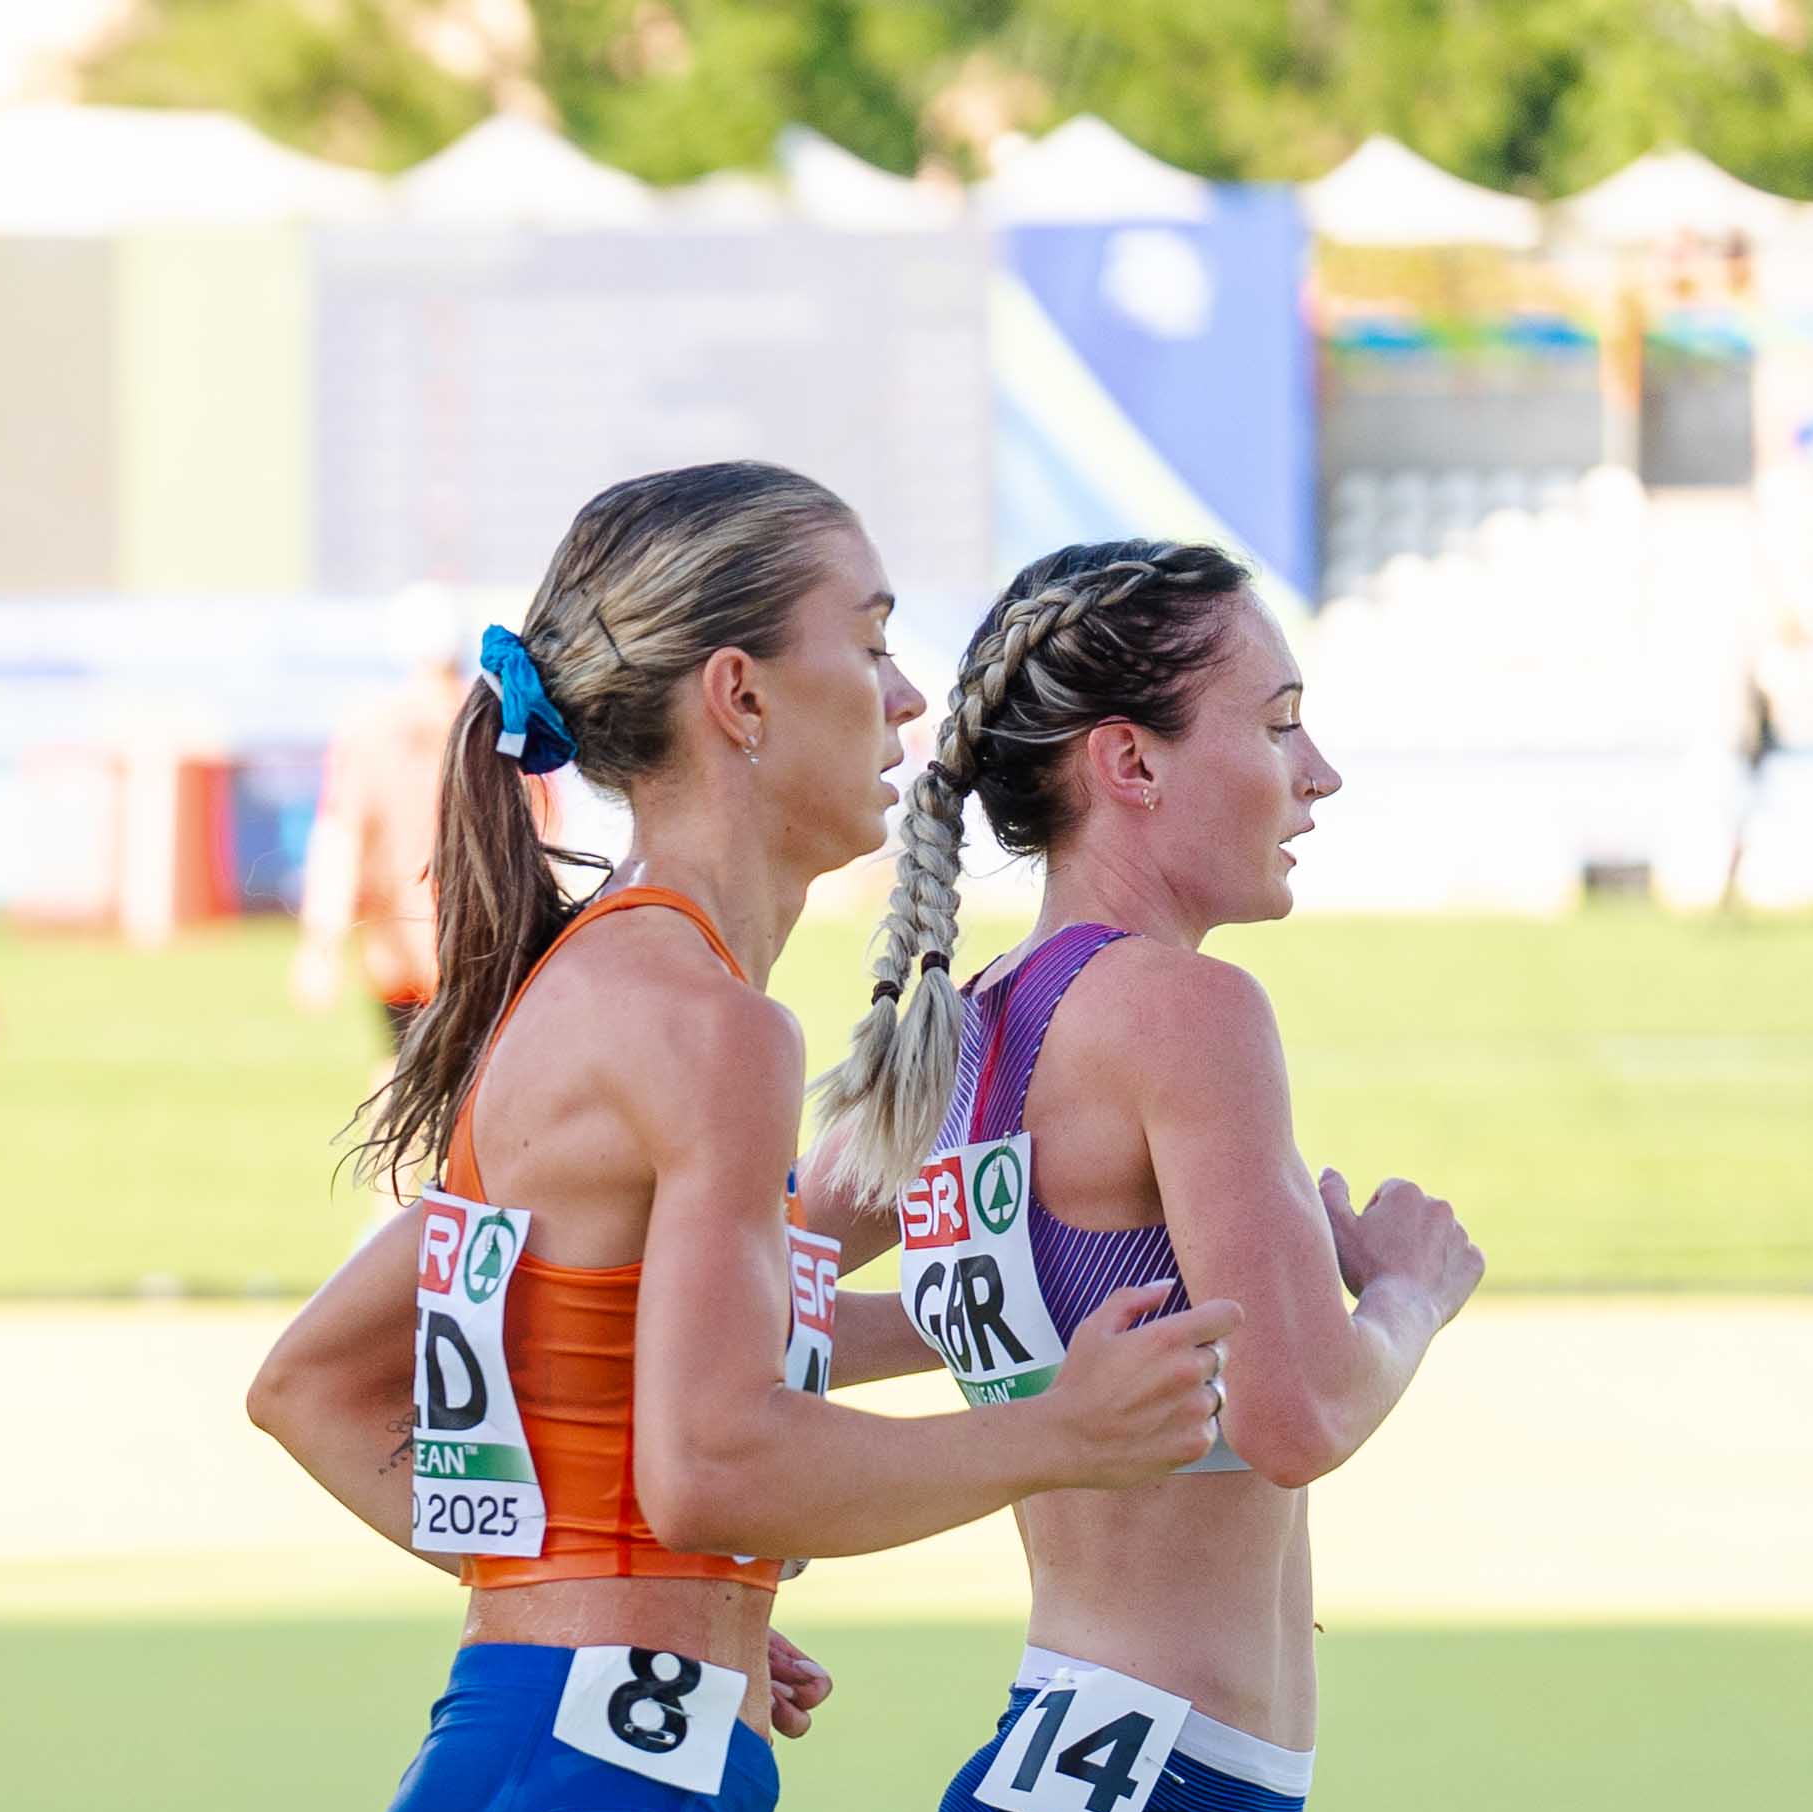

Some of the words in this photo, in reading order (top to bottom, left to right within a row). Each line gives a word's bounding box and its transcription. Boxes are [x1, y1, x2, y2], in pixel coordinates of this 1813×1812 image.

[914, 1254, 1035, 1374] GBR
[428, 1493, 520, 1537] 2025
[608, 1646, 702, 1754] 8
